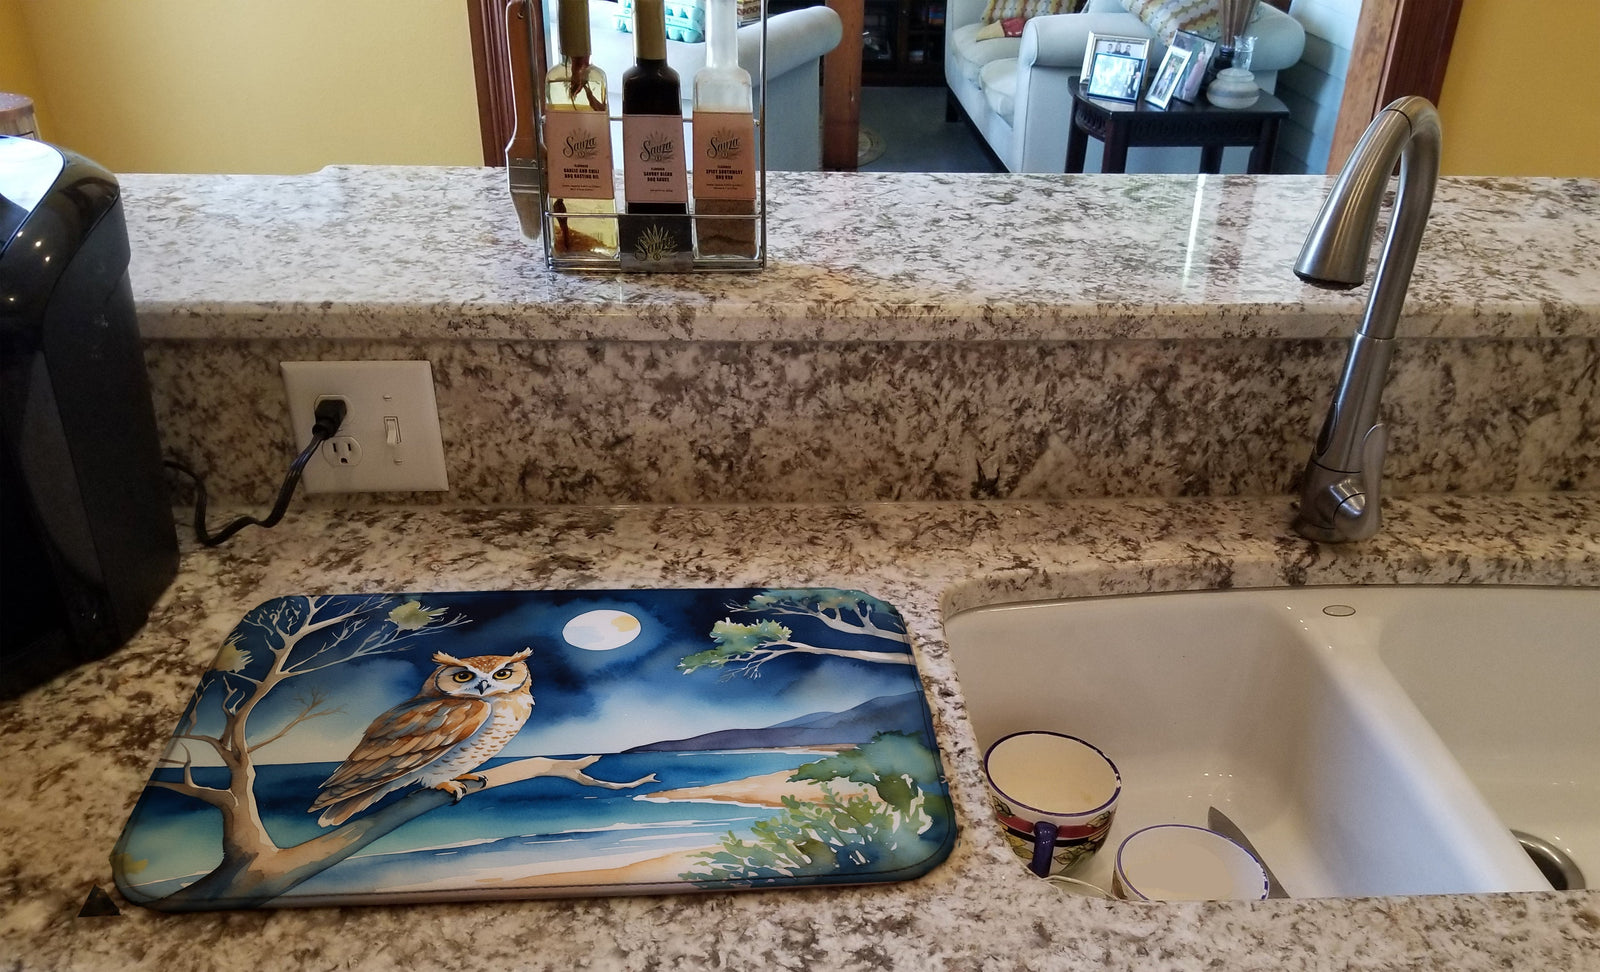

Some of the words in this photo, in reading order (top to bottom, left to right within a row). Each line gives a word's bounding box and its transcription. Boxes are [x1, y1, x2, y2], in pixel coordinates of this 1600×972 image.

[562, 136, 597, 158] Sauza
[639, 140, 673, 162] Sauza
[706, 137, 739, 159] Sauza
